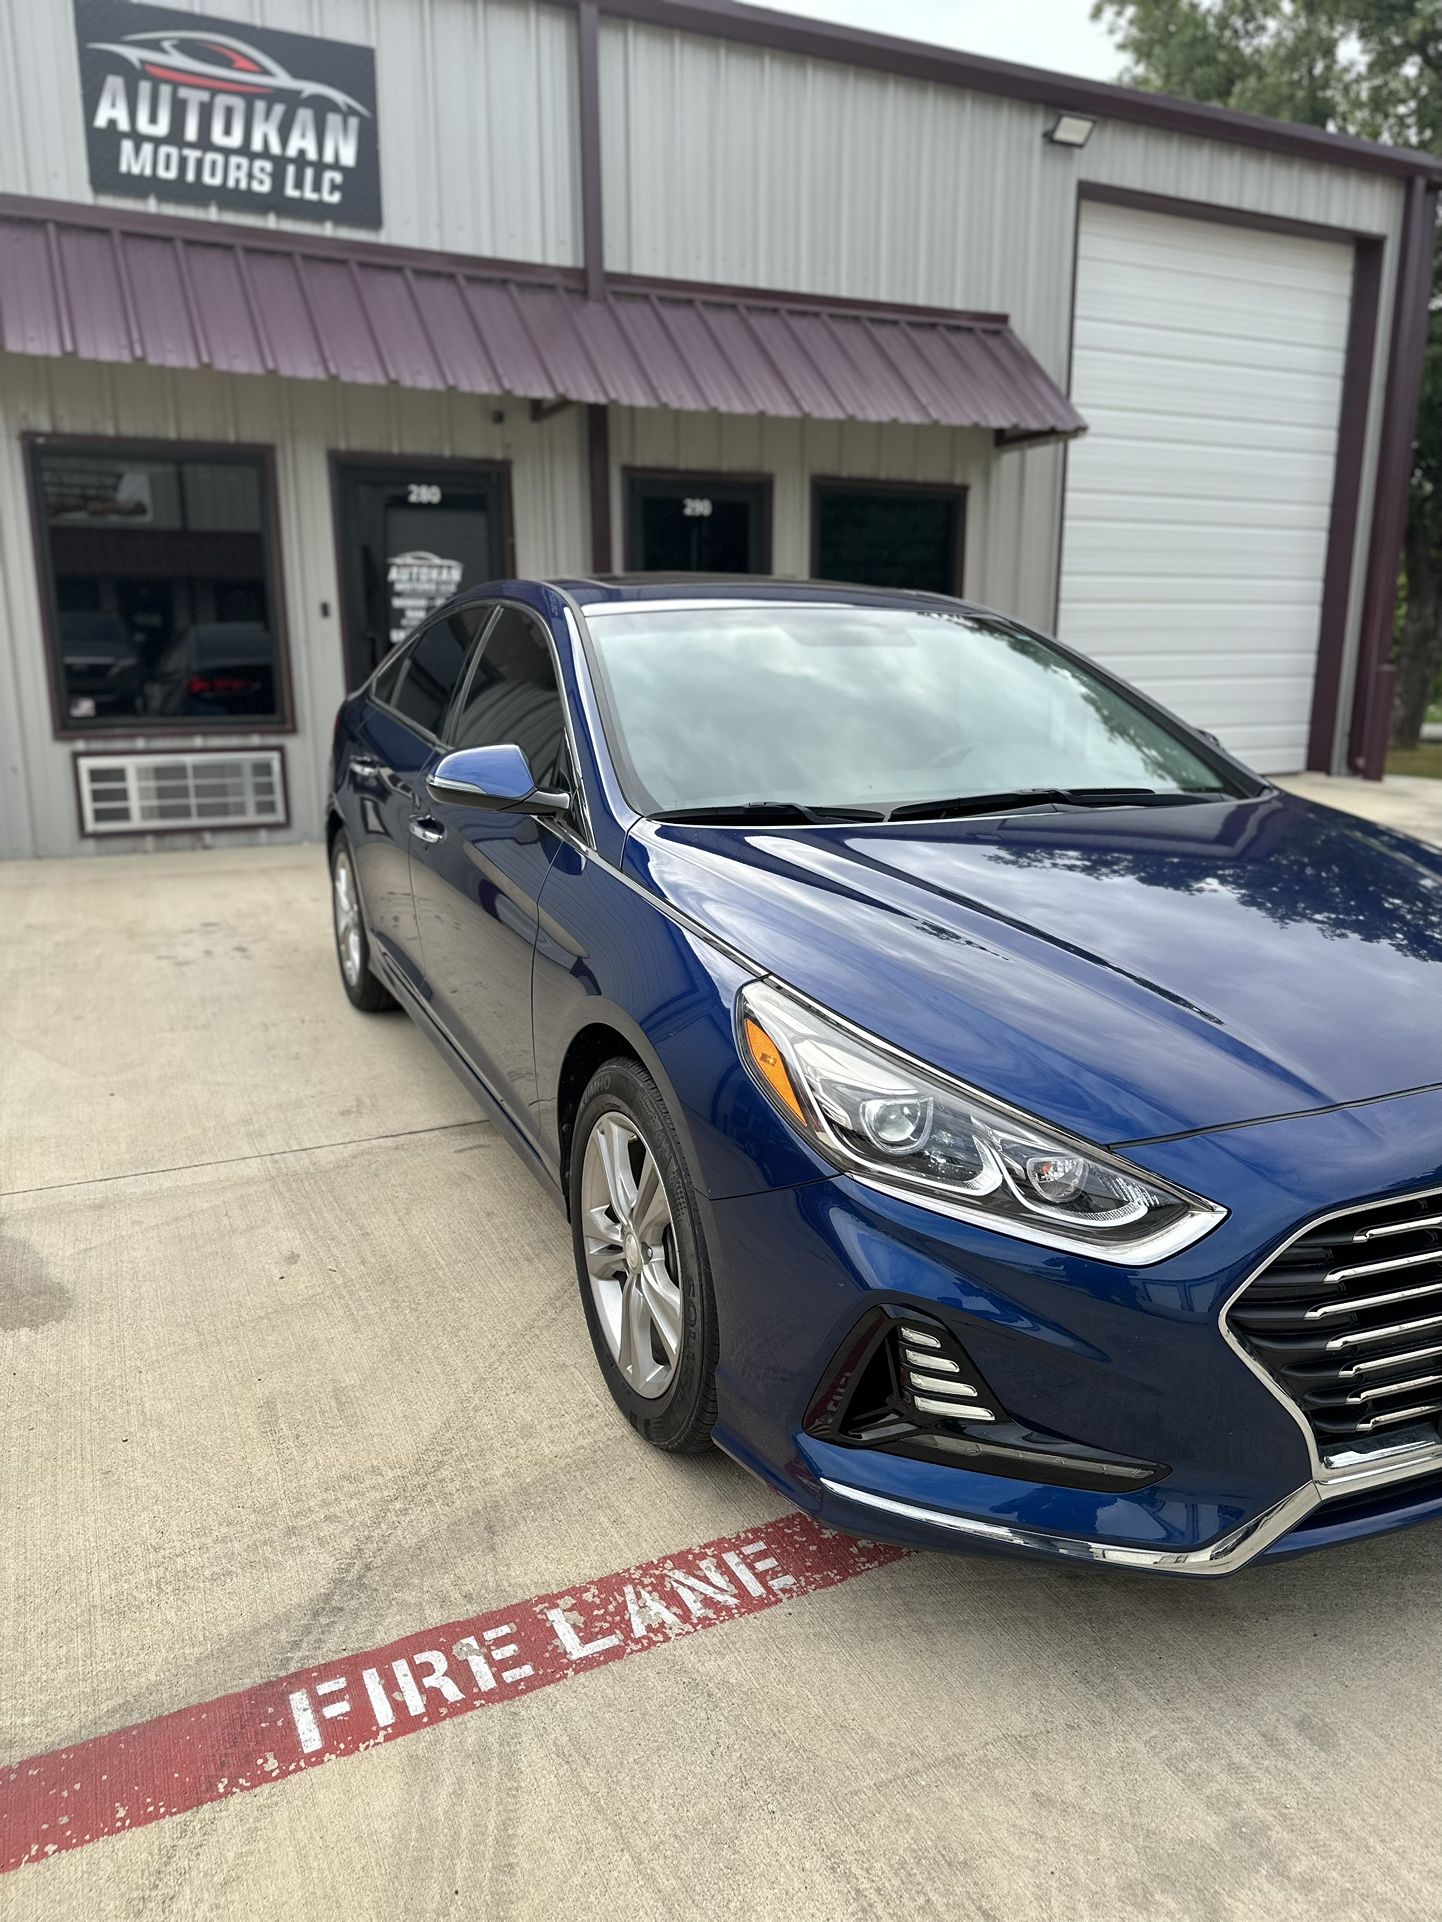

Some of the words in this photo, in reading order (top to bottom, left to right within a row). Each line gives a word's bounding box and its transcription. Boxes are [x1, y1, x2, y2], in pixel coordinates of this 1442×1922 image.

[94, 74, 359, 168] AUTOKAN
[119, 139, 273, 194] MOTORS
[284, 163, 343, 204] LLC
[288, 1624, 534, 1754] FIRE
[546, 1541, 797, 1660] LANE
